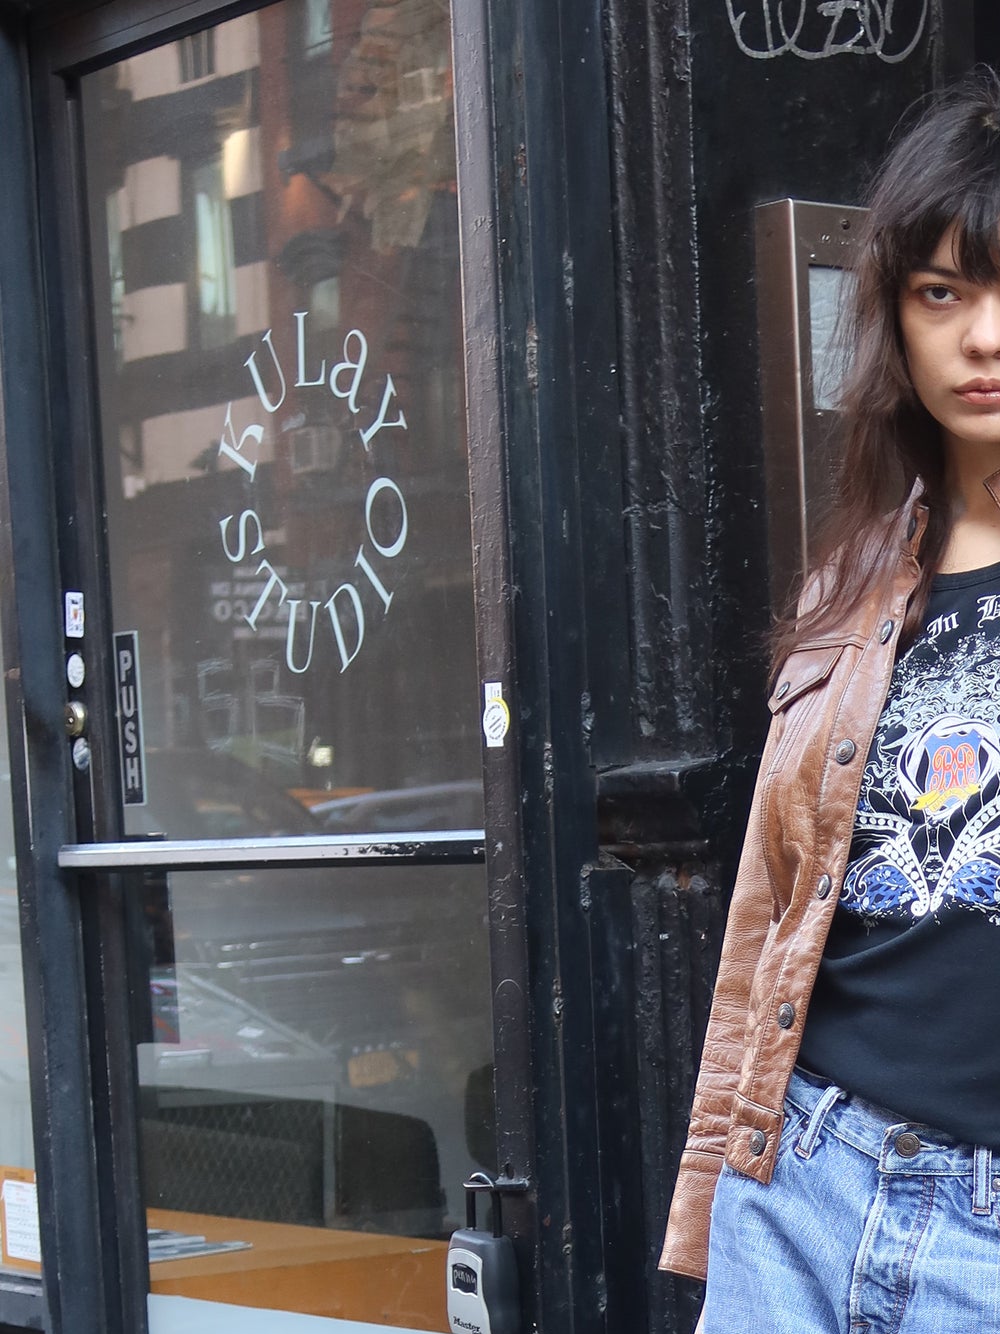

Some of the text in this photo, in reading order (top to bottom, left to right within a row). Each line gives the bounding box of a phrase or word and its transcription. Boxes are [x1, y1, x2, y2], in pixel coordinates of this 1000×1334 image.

[219, 477, 408, 673] STUDIO
[119, 650, 140, 789] PUSH
[453, 1316, 480, 1332] Master
